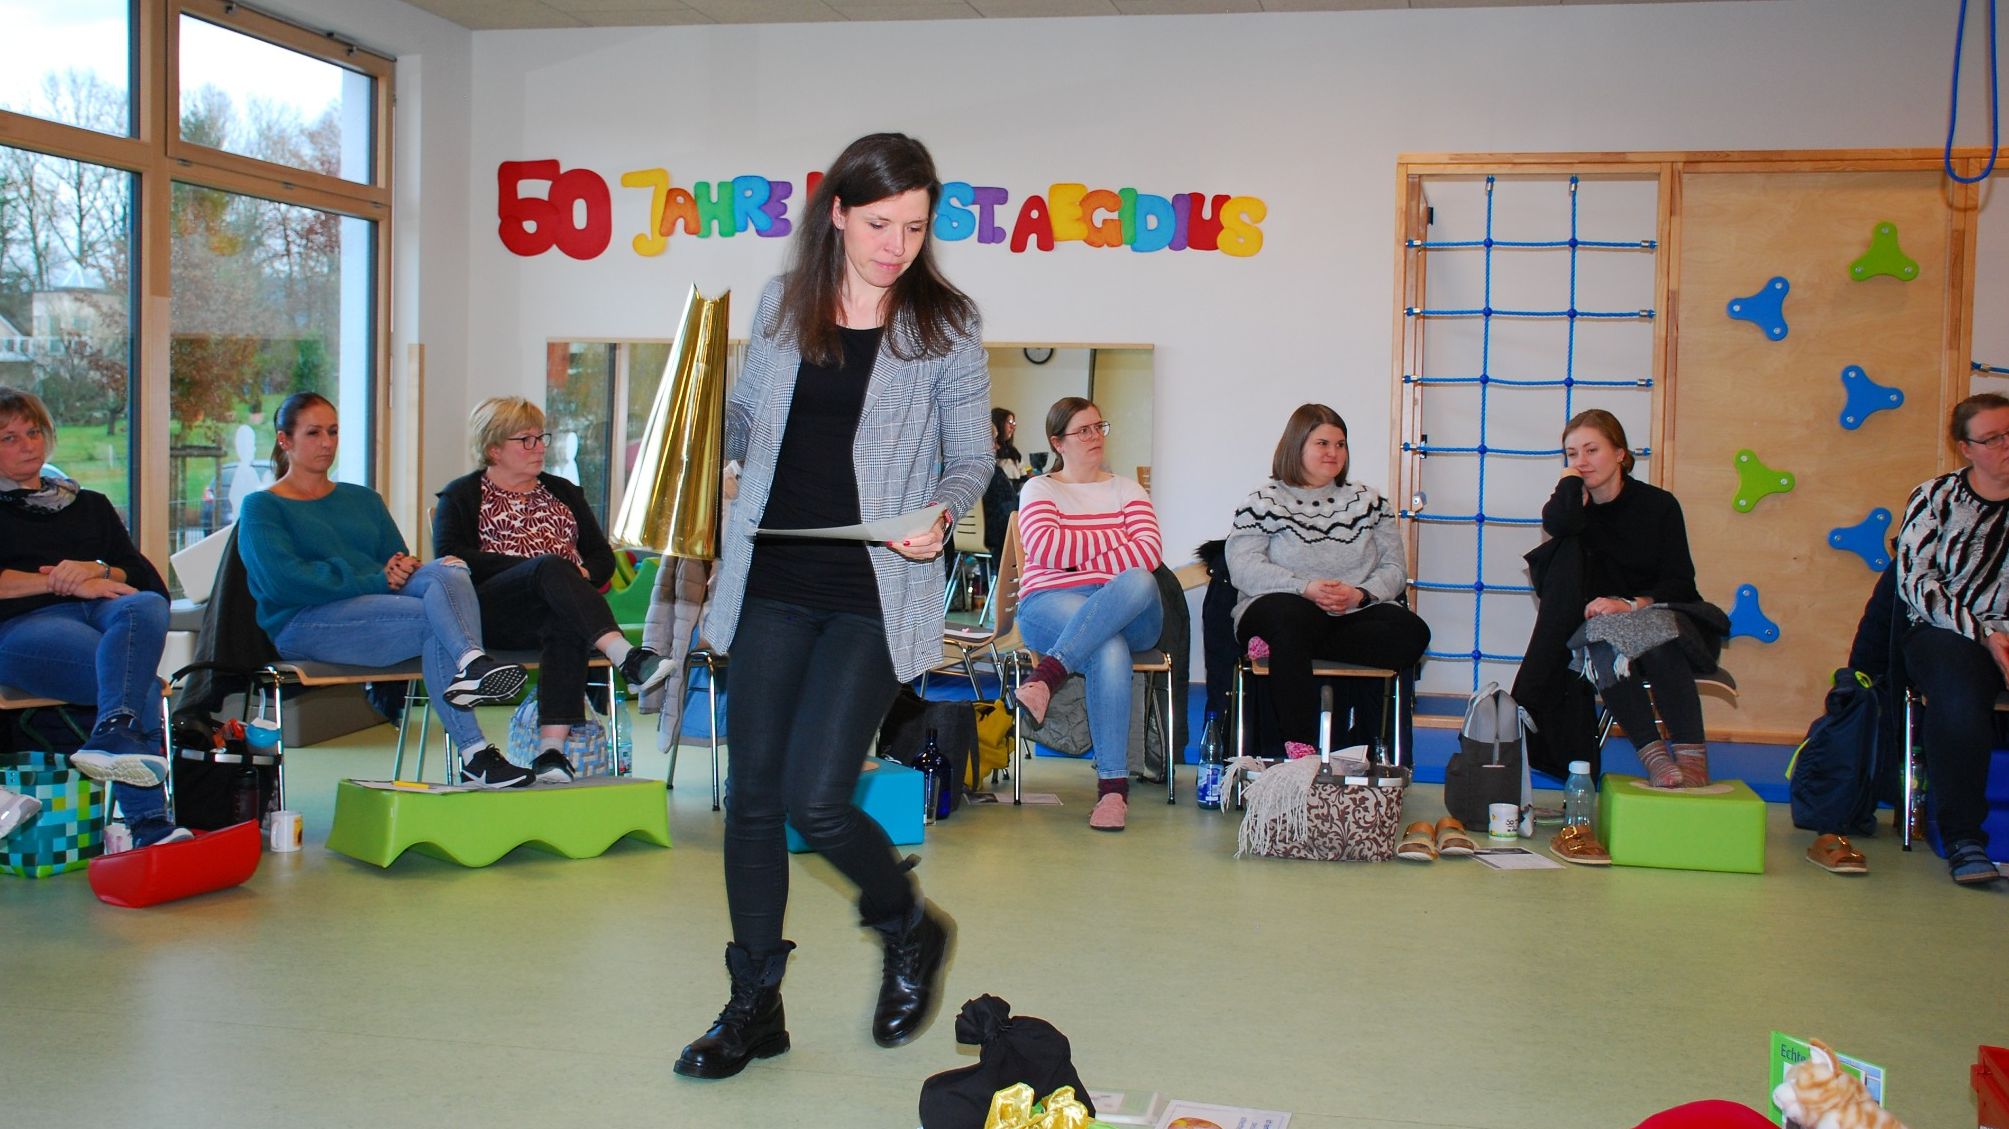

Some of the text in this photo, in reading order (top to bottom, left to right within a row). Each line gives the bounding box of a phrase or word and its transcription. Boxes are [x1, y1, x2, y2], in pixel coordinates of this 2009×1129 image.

[497, 158, 613, 260] 50
[620, 167, 794, 257] JAHRE
[1010, 182, 1268, 258] AEGIDIUS
